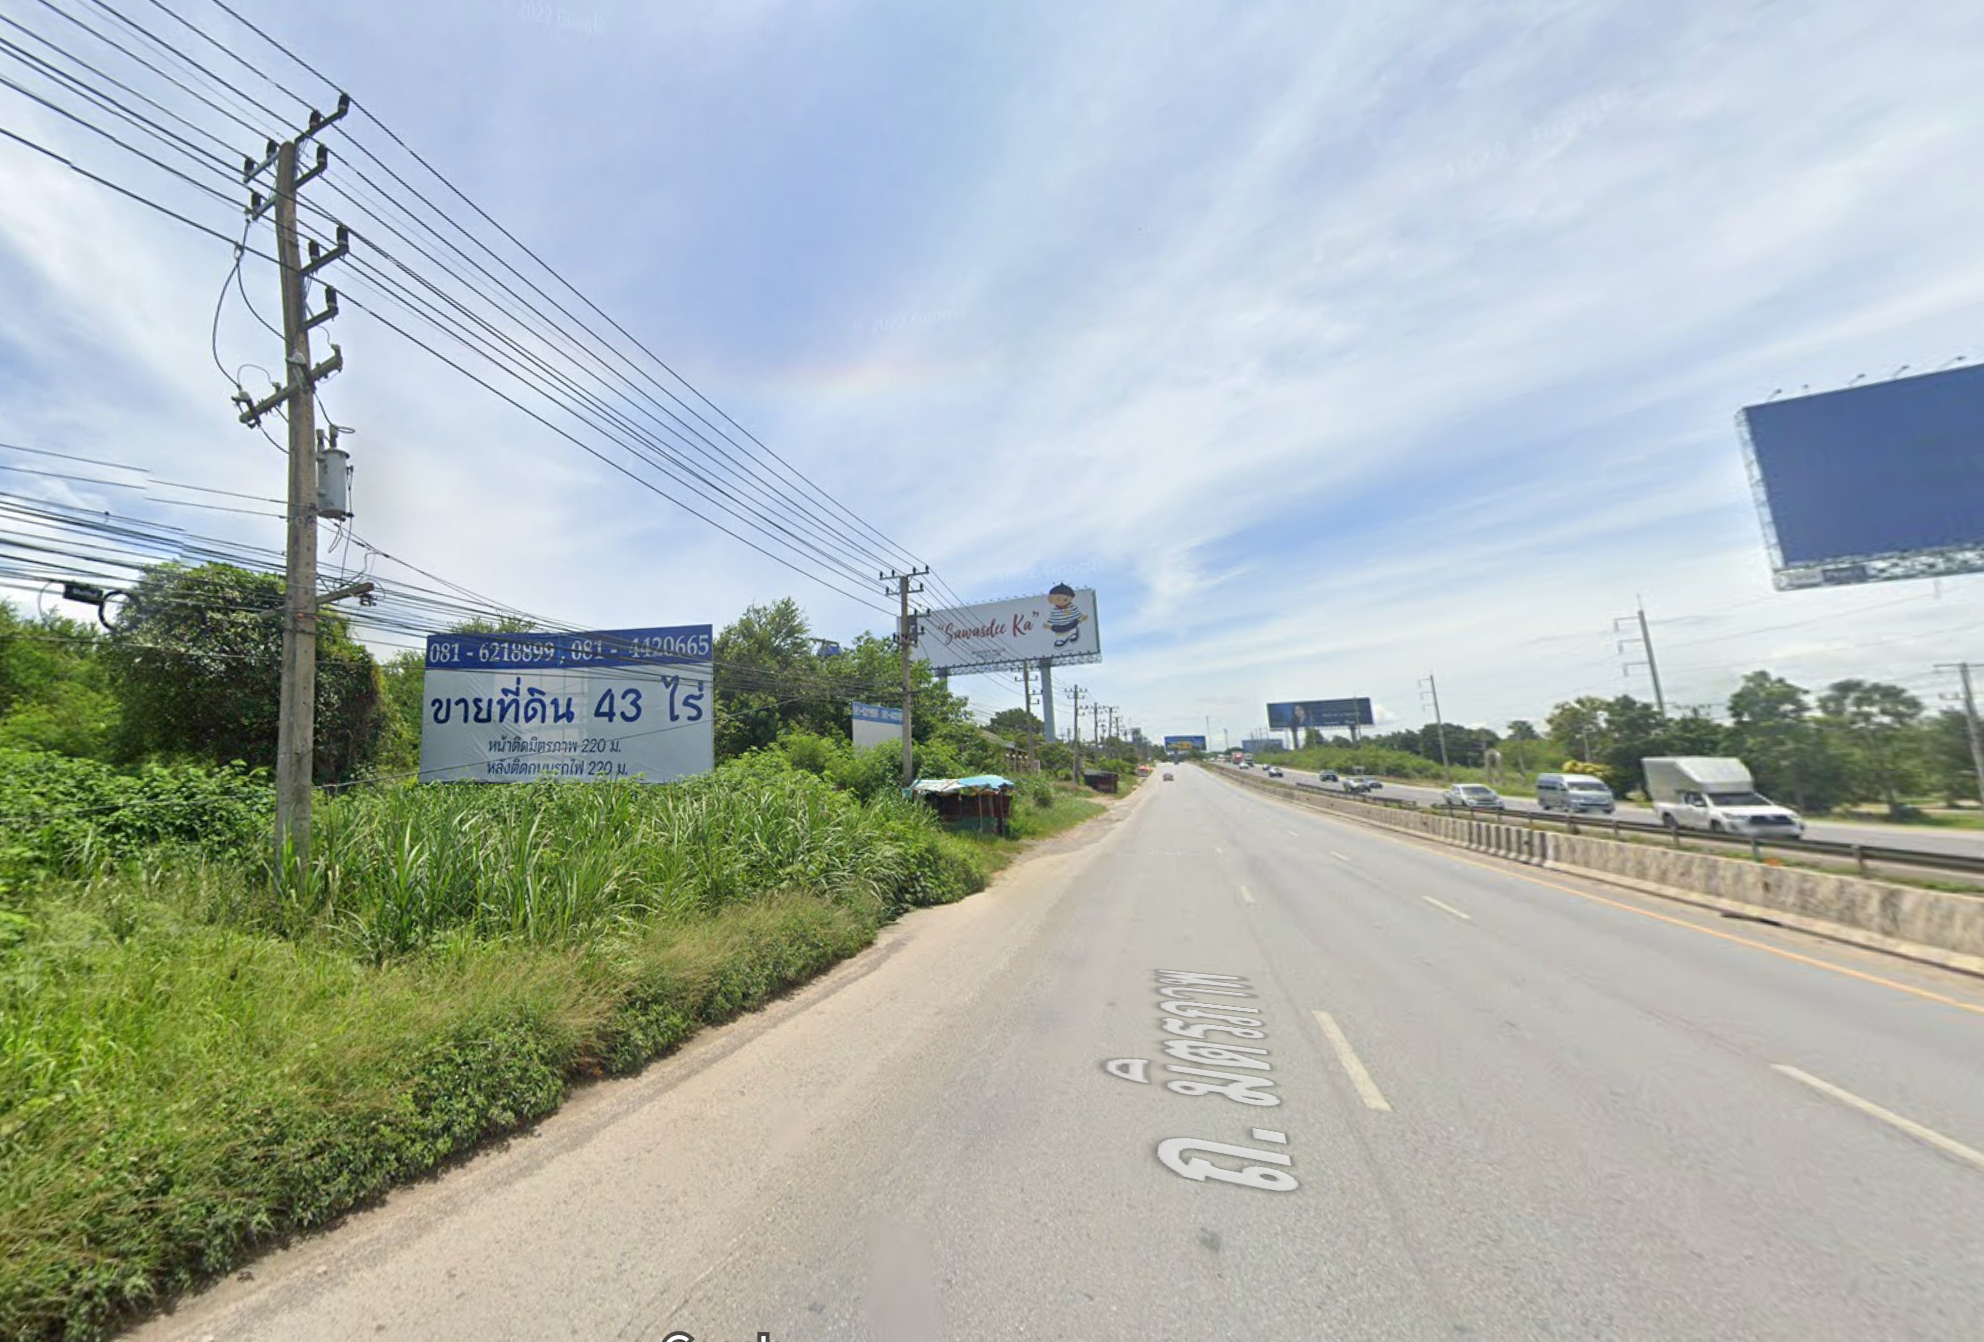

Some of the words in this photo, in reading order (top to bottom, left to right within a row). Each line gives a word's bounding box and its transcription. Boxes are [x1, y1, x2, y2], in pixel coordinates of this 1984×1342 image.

[429, 642, 460, 663] 081
[479, 641, 555, 662] 6218899
[571, 640, 604, 661] 081
[628, 634, 709, 658] 4420665
[430, 676, 576, 724] ขายที่ดิน
[593, 687, 643, 723] 43
[661, 674, 705, 722] ไร่
[581, 739, 606, 753] 220
[587, 761, 613, 775] 220
